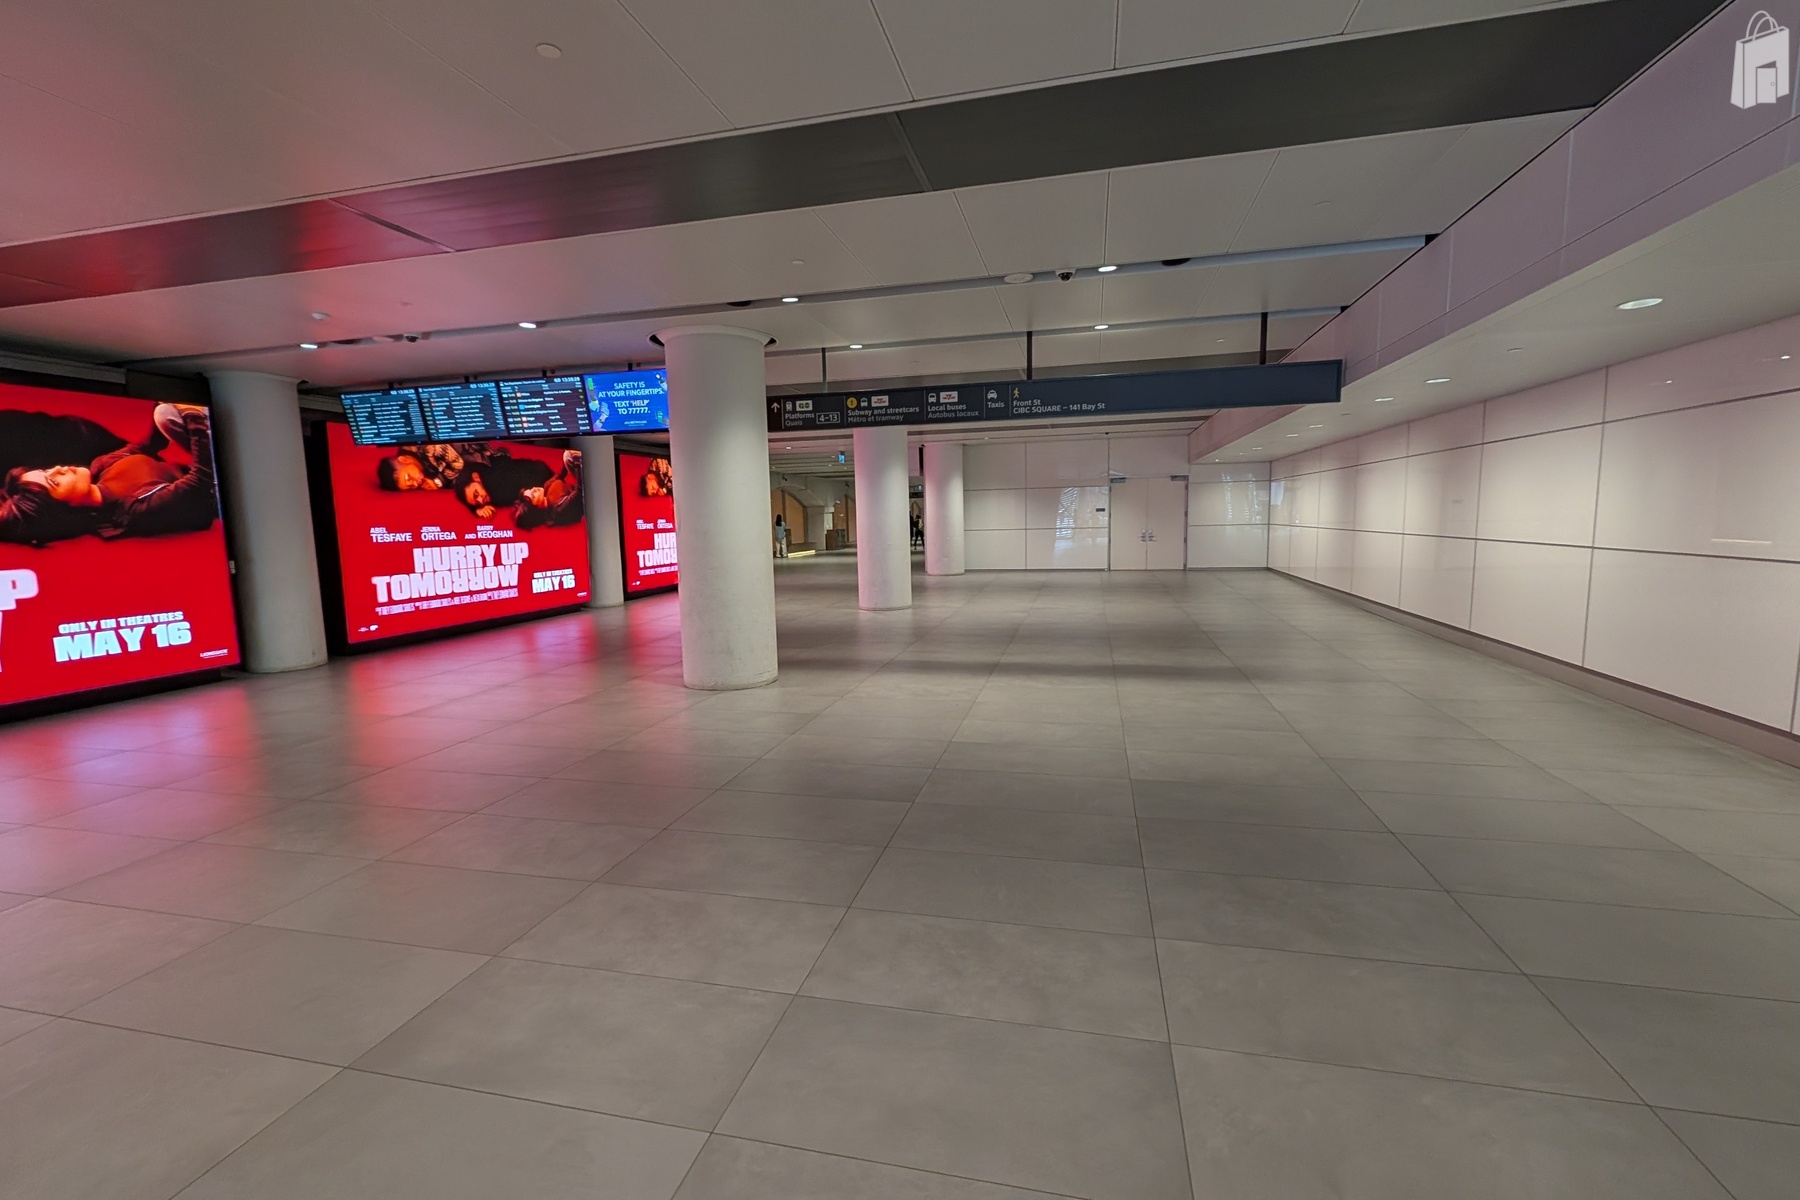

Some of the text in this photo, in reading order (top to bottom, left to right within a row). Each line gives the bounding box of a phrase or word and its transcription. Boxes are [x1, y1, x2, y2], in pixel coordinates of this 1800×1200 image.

[626, 388, 664, 396] FINGERTIPS.
[370, 533, 412, 542] TESFAYE
[421, 532, 457, 541] ORTEGA
[477, 530, 513, 539] KEOGHAN
[654, 532, 677, 550] HUR
[413, 542, 529, 572] HURRY UP
[637, 548, 678, 568] TOMOR
[0, 568, 39, 611] P
[372, 564, 519, 603] TOMORROW
[532, 574, 576, 594] MAY 16
[58, 611, 184, 634] ONLY IN THEATRES
[53, 622, 192, 662] MAY 16
